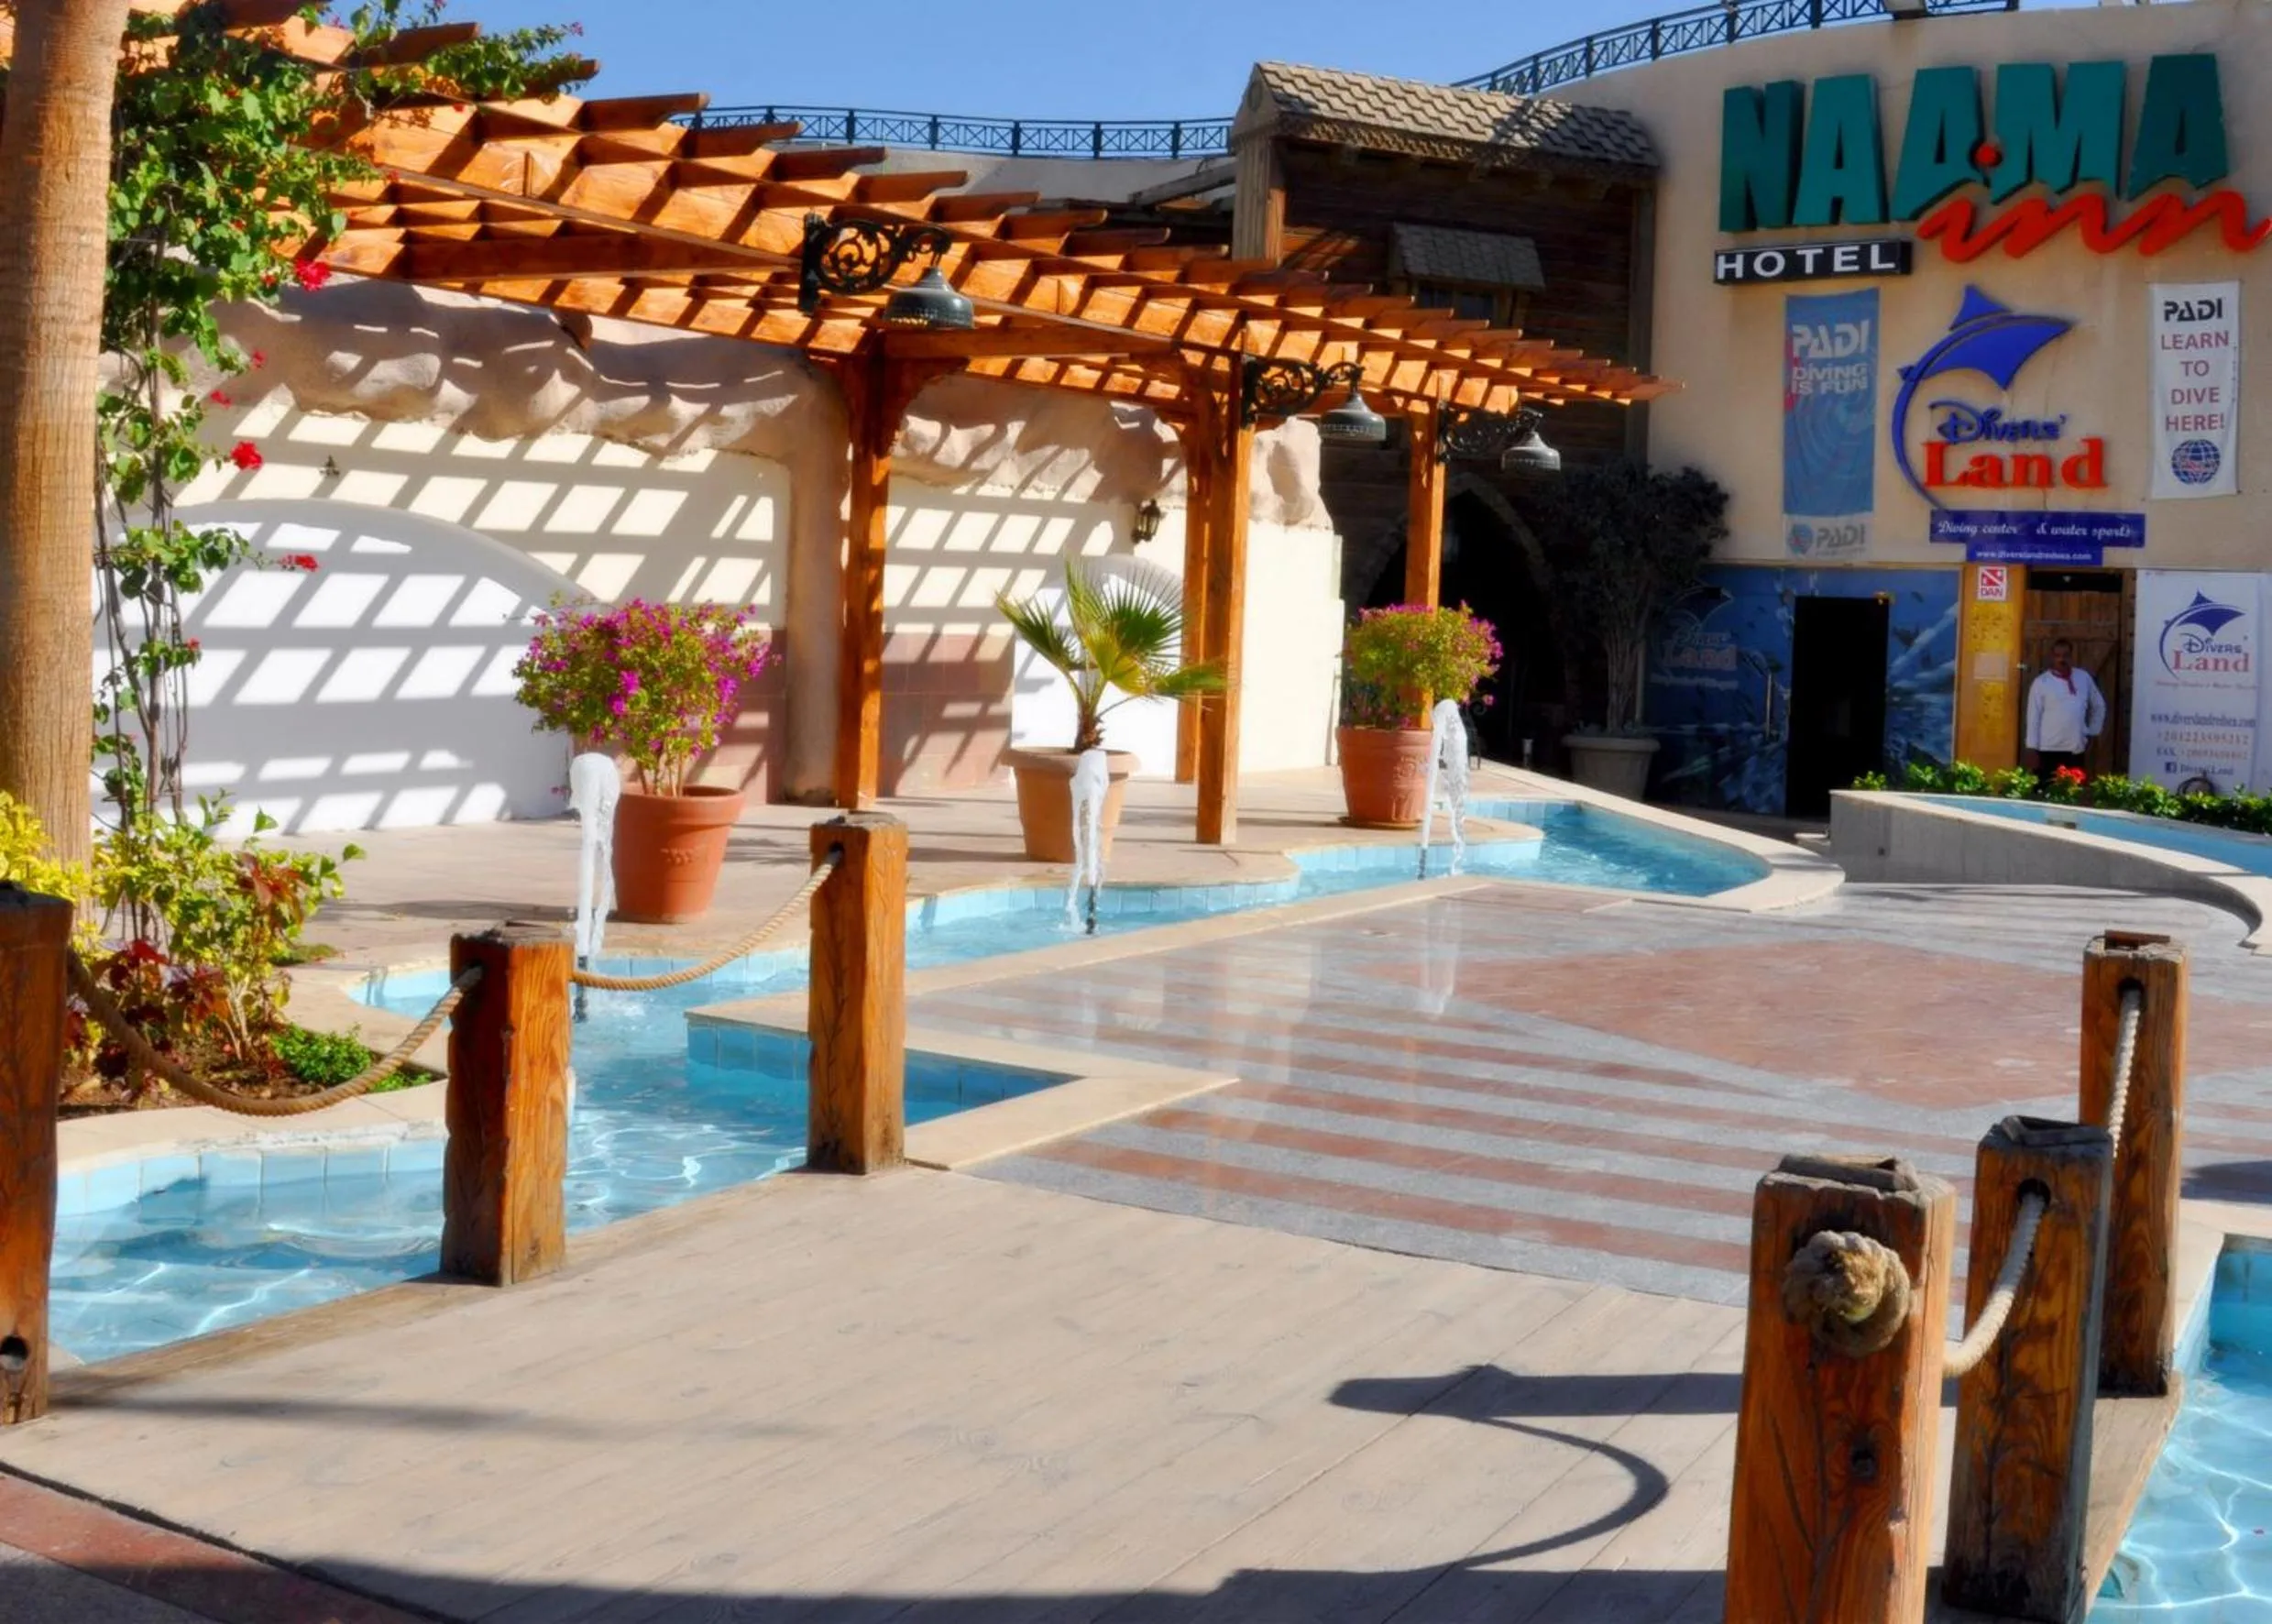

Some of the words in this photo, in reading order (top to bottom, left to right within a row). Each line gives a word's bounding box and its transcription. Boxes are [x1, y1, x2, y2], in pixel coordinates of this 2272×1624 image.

[1719, 53, 2229, 232] NAAMA
[1716, 245, 1896, 280] HOTEL
[2164, 297, 2223, 322] PADI
[1792, 319, 1870, 358] PADI
[2161, 330, 2230, 350] LEARN
[1793, 363, 1868, 380] DIVING
[2179, 359, 2210, 378] TO
[1792, 380, 1813, 396] IS
[1820, 378, 1868, 395] FUN
[2171, 387, 2221, 405] DIVE
[2165, 413, 2225, 432] HERE!
[1923, 435, 2111, 490] Land
[1817, 523, 1866, 549] PADI
[1937, 520, 1978, 537] Diving
[1981, 523, 2018, 536] center
[2050, 523, 2088, 537] water
[2091, 523, 2133, 540] sports
[2173, 649, 2250, 673] Land
